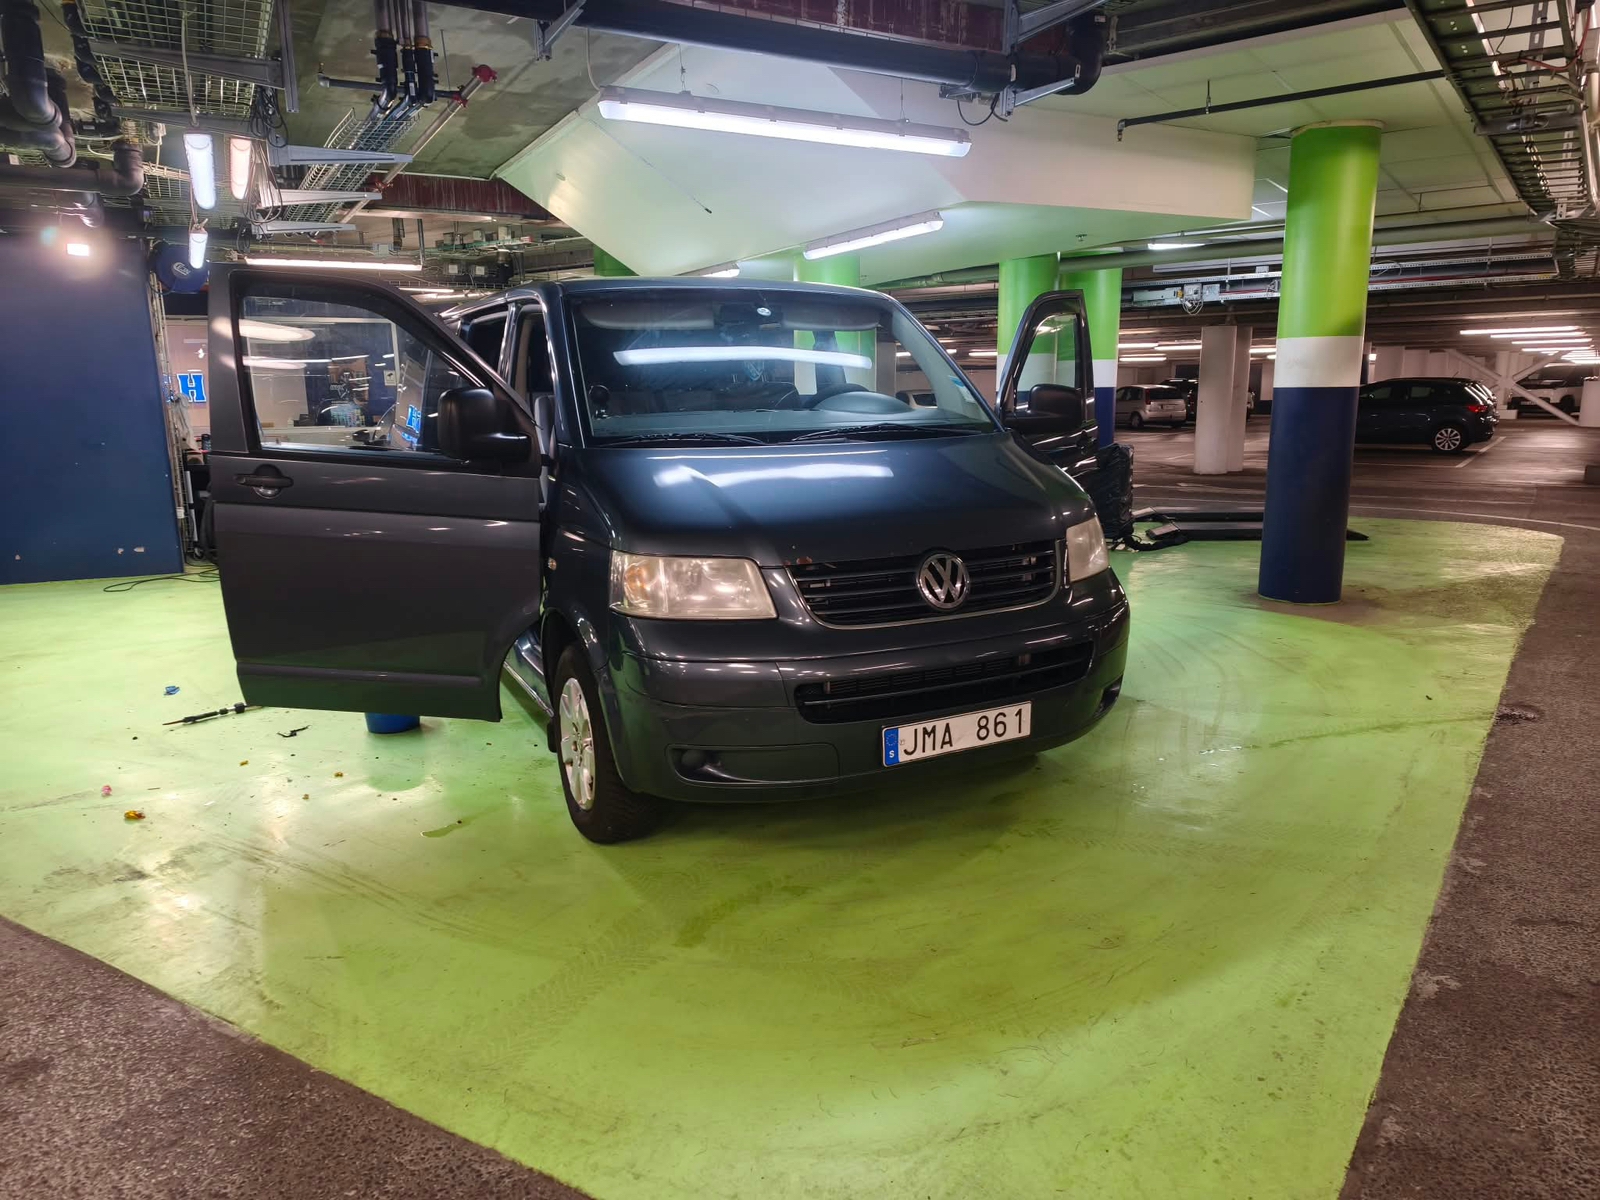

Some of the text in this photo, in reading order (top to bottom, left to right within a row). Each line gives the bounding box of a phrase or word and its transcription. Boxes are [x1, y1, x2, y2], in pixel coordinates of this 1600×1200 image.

[903, 708, 1023, 756] JMA 861
[889, 750, 896, 759] S
